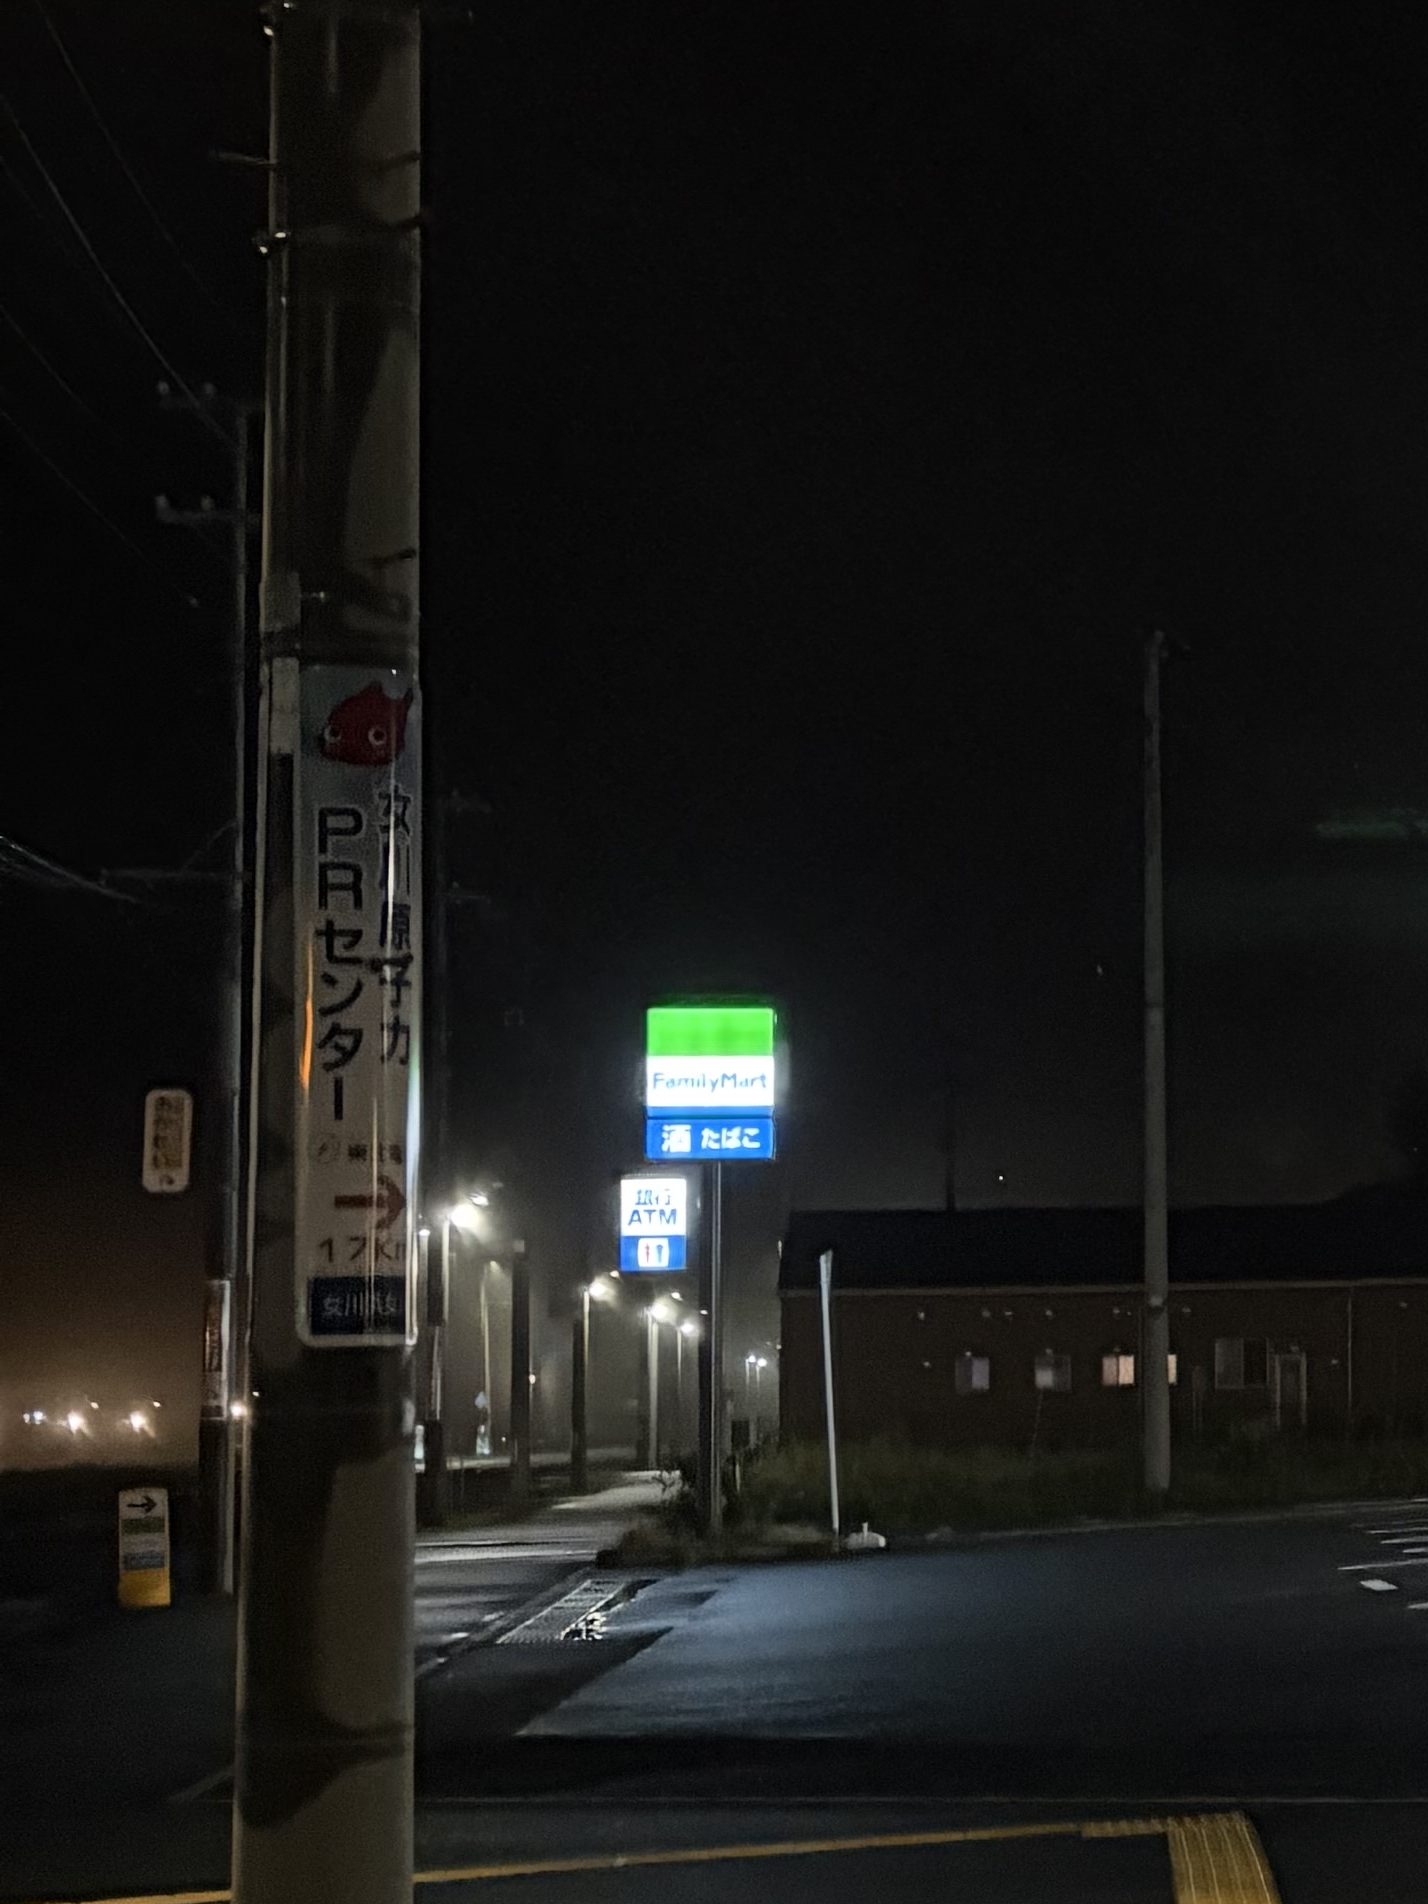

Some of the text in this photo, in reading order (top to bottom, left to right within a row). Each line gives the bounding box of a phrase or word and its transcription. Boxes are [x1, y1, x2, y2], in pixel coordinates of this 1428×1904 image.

[317, 806, 364, 1121] PRセンター
[653, 1073, 767, 1093] FamilyMart
[661, 1124, 760, 1152] 酒 たばこ
[628, 1208, 677, 1226] ATM
